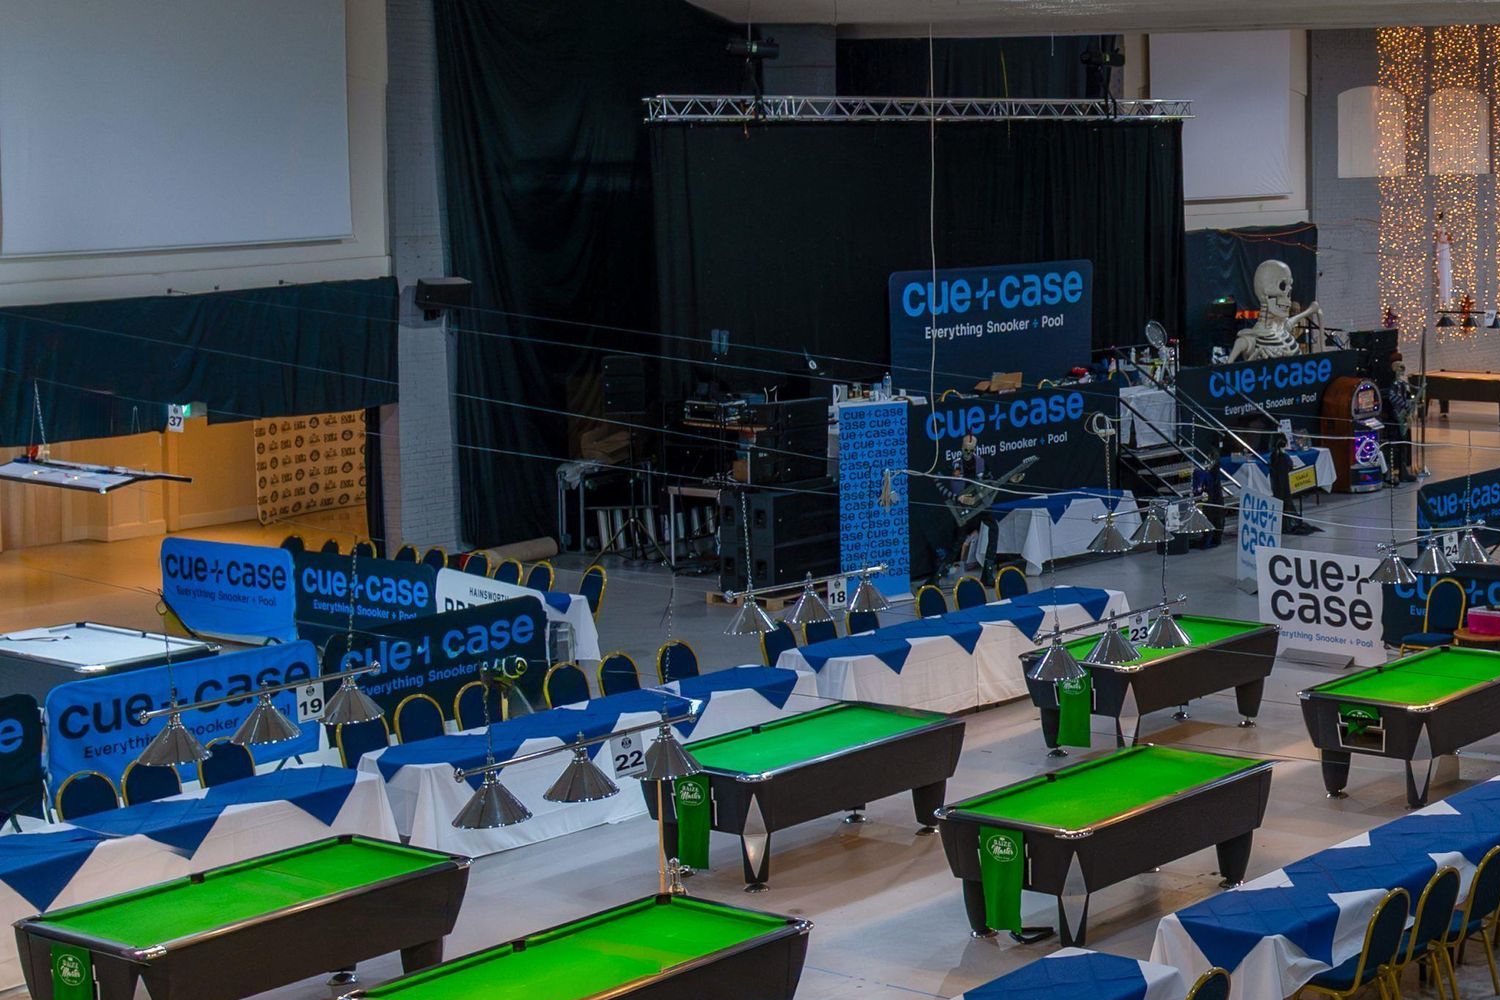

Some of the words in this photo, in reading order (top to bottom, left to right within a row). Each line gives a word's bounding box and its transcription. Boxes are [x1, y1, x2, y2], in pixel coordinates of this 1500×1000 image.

[902, 271, 1083, 317] cue+case
[925, 322, 983, 340] Everything
[987, 318, 1030, 333] Snooker
[1041, 314, 1064, 328] Pool
[1209, 358, 1332, 398] cue+case
[1265, 397, 1294, 409] Snooker
[1302, 393, 1317, 403] Pool
[169, 416, 182, 427] 37
[843, 408, 904, 420] cue+case
[926, 391, 1084, 440] cue+case
[999, 437, 1037, 452] Snooker
[1048, 431, 1068, 444] Pool
[1243, 492, 1278, 531] cue+
[1445, 544, 1458, 557] 24
[165, 553, 287, 591] cue+case
[1269, 555, 1370, 595] cue+
[176, 585, 215, 601] Everything
[218, 590, 250, 604] Snooker
[258, 596, 277, 607] Pool
[302, 568, 429, 607] cue+case
[830, 591, 846, 604] 18
[313, 599, 353, 614] Everything
[357, 604, 390, 619] Snooker
[1271, 589, 1373, 631] case
[1130, 627, 1148, 642] 23
[1316, 633, 1346, 645] Snooker
[1356, 638, 1374, 648] Pool
[340, 614, 534, 680] cue+case
[428, 663, 478, 682] Snooker
[300, 698, 322, 716] 19
[615, 750, 645, 772] 22
